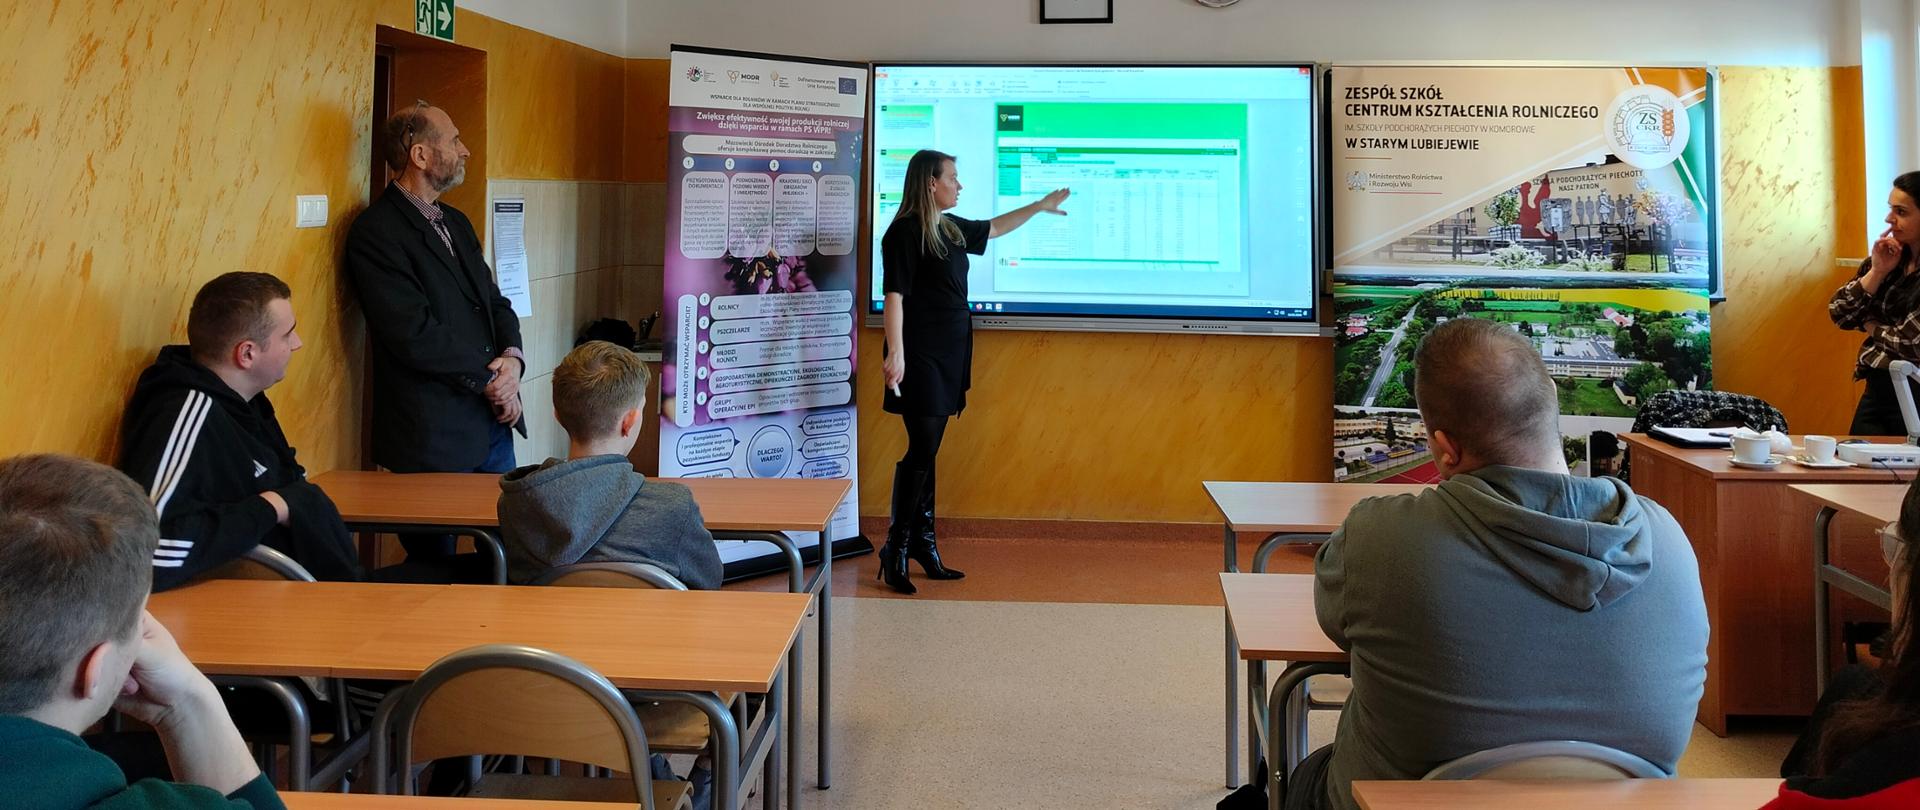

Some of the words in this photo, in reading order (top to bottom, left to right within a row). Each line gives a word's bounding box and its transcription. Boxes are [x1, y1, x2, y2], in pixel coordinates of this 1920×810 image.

[1344, 84, 1397, 100] ZESPÓŁ
[1400, 85, 1444, 100] SZKÓŁ
[1345, 104, 1412, 117] CENTRUM
[1416, 104, 1508, 117] KSZTAŁCENIA
[1512, 106, 1598, 118] ROLNICZEGO
[696, 112, 725, 122] Zwiększ
[726, 113, 768, 124] efektywność
[770, 117, 790, 126] swojej
[792, 118, 822, 127] produkcji
[824, 120, 849, 129] rolniczej
[1640, 112, 1657, 124] ZS
[718, 121, 739, 130] dzięki
[740, 123, 769, 132] wsparciu
[1384, 124, 1442, 133] PODCHORĄŻYCH
[1444, 124, 1479, 132] PIECHOTY
[1345, 138, 1357, 148] W
[1360, 138, 1408, 149] STARYM
[1411, 139, 1479, 150] LUBIEJEWIE
[1556, 174, 1606, 184] PODCHORĄŻYCH
[1610, 170, 1643, 179] PIECHOTY
[716, 373, 755, 381] GOSPODARSTWA
[757, 369, 801, 378] DEMONSTRACYJNE,
[716, 380, 764, 389] AGROTURYSTYCZNE,
[714, 405, 746, 413] OPERACYJNE
[757, 447, 784, 456] DLACZEGO
